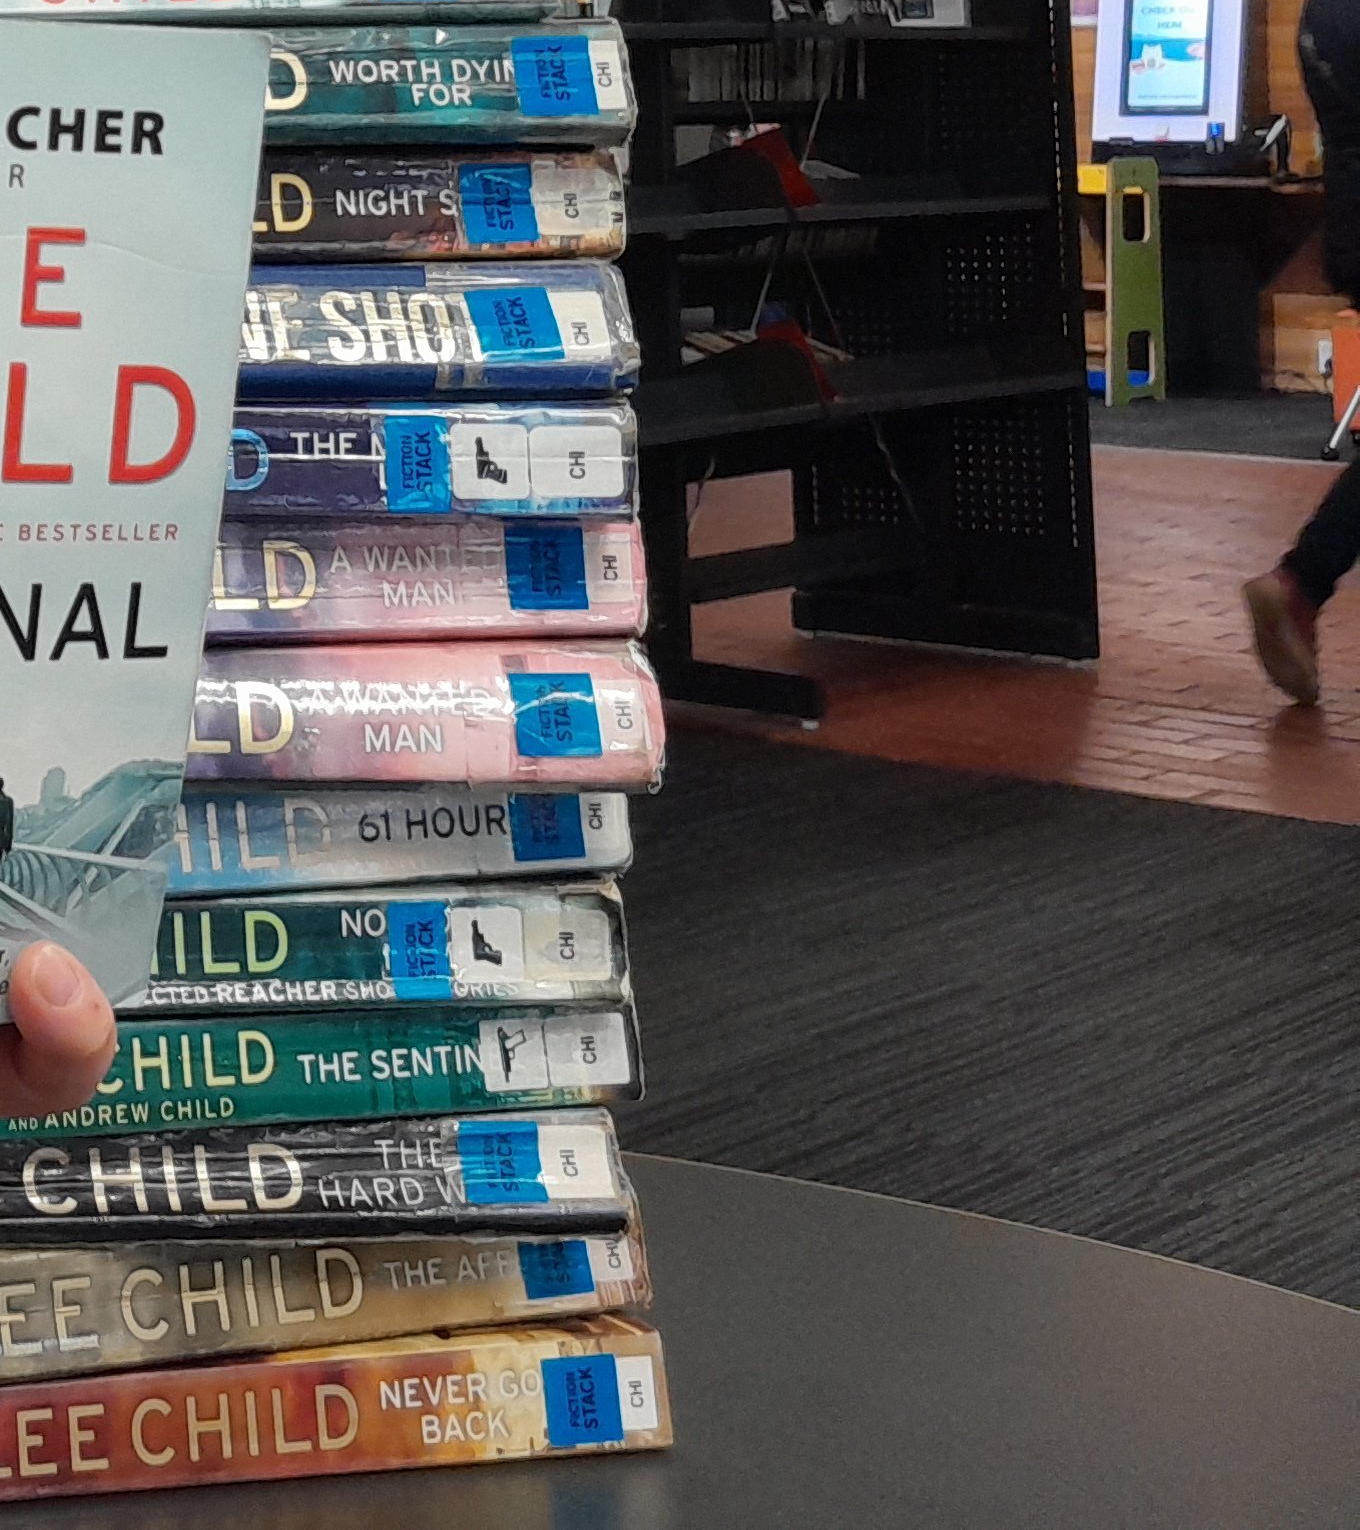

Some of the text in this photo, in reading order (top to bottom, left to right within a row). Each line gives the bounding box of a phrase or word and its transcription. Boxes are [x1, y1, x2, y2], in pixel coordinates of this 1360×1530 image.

[329, 59, 441, 85] WORTH
[548, 44, 571, 102] STACK
[596, 61, 613, 88] CHI
[412, 83, 473, 107] FOR
[335, 189, 427, 217] NIGHT
[494, 175, 516, 232] STACK
[563, 192, 580, 219] CHI
[510, 294, 537, 352] STACK
[570, 320, 591, 348] CHI
[289, 431, 357, 460] THE
[414, 430, 434, 495] STACK
[568, 449, 587, 480] CHI
[17, 521, 180, 544] BESTSELLER
[329, 546, 353, 573] A
[602, 554, 619, 582] CHI
[382, 578, 458, 608] MAN
[614, 700, 634, 731] CHI
[363, 724, 444, 754] MAN
[357, 812, 393, 844] 61
[589, 801, 604, 830] CHI
[418, 918, 436, 980] STACK
[558, 931, 577, 960] CHI
[216, 979, 339, 1004] REACHER
[580, 1035, 597, 1065] CHI
[296, 1052, 360, 1085] THE
[8, 1096, 235, 1132] AND ANDREW CHILD
[496, 1131, 521, 1192] STACK
[562, 1148, 579, 1178] CHI
[22, 1142, 304, 1216] CHILD
[318, 1175, 425, 1209] HARD
[383, 1257, 447, 1291] THE
[119, 1247, 365, 1341] CHILD
[379, 1368, 543, 1411] NEVER GO
[568, 1371, 581, 1428] FICTION
[577, 1366, 600, 1431] STACK
[628, 1379, 645, 1409] CHI
[130, 1383, 360, 1466] CHILD
[420, 1409, 511, 1445] BACK
